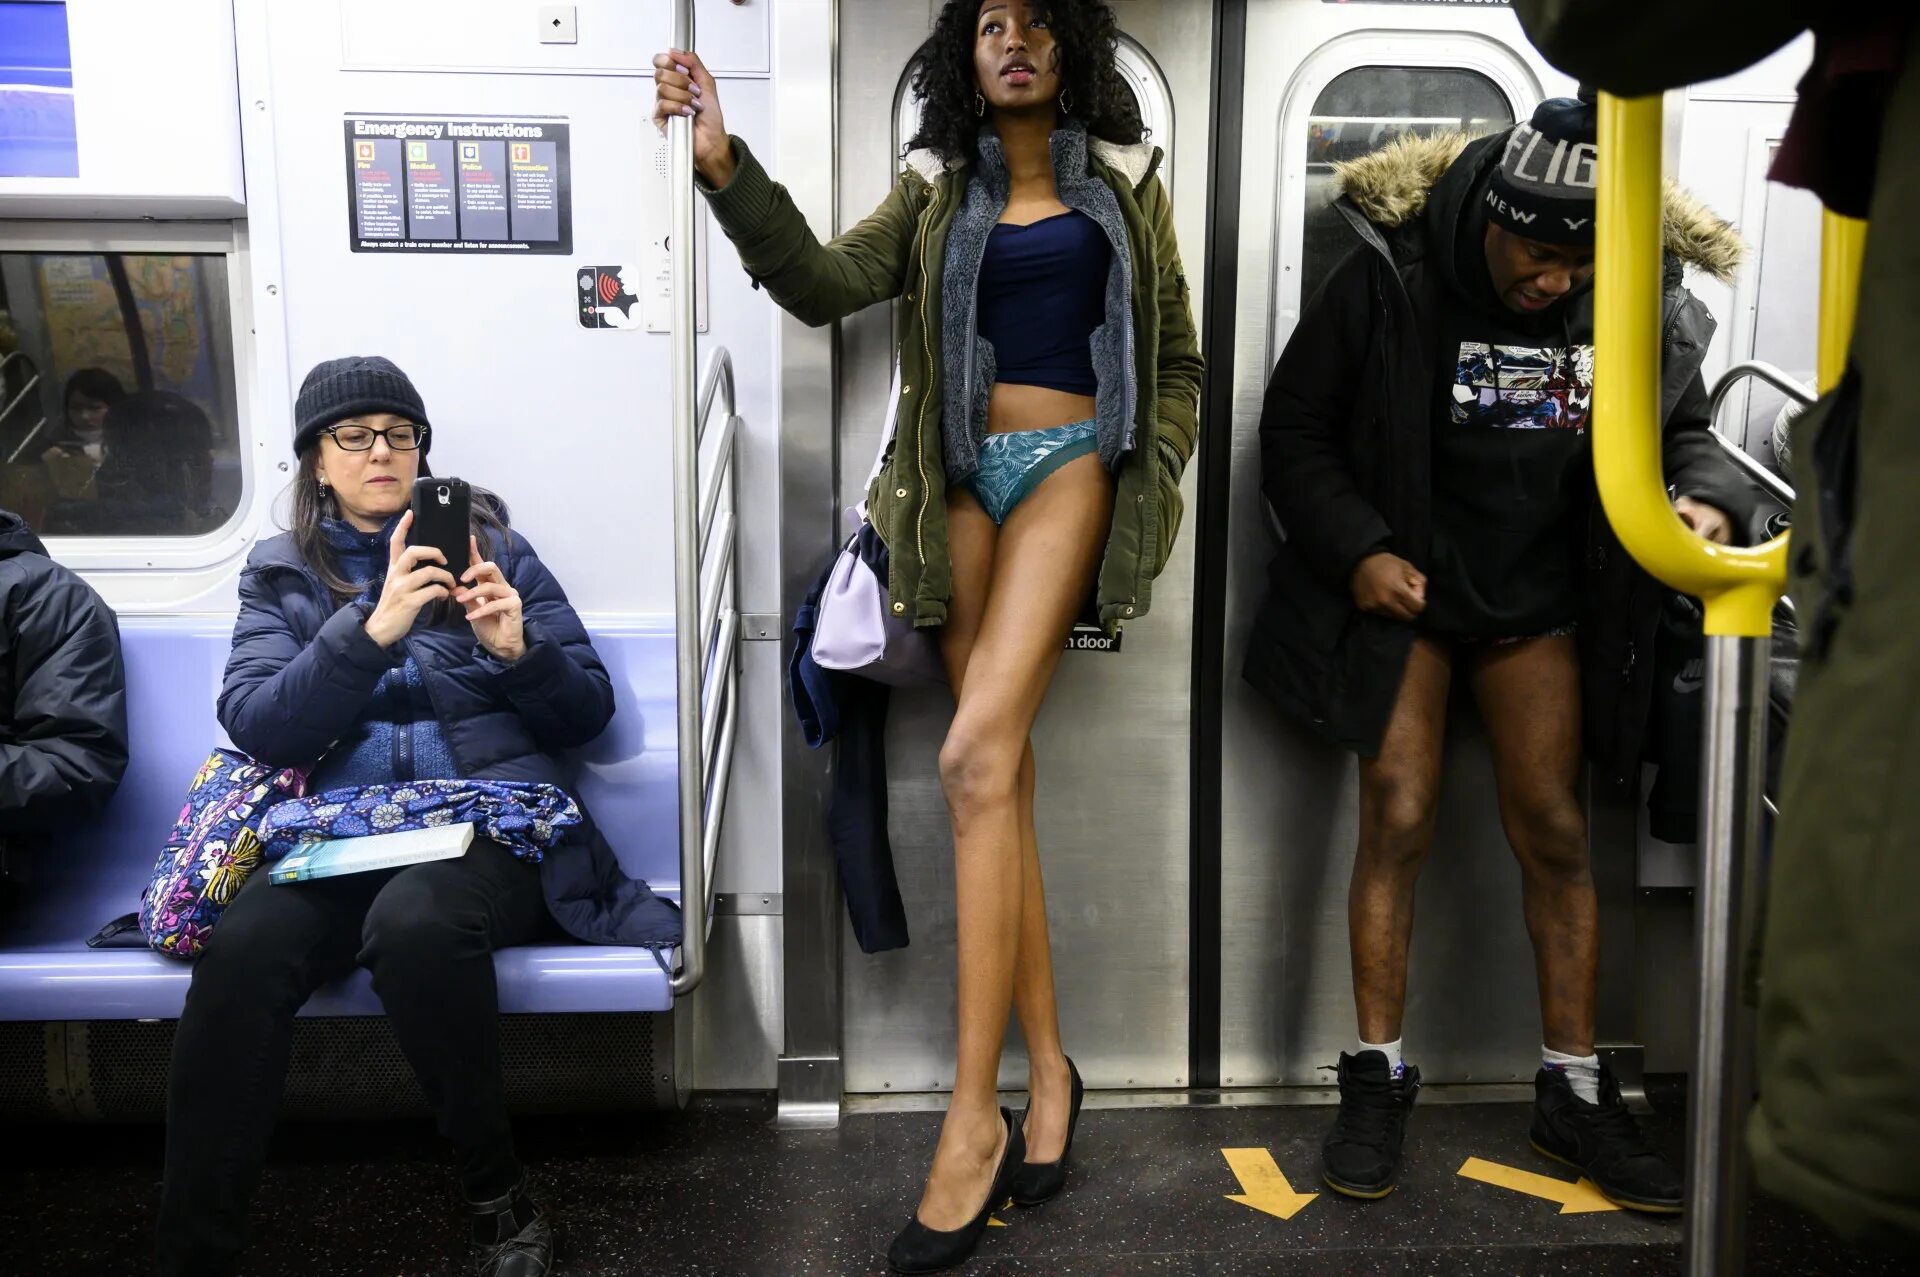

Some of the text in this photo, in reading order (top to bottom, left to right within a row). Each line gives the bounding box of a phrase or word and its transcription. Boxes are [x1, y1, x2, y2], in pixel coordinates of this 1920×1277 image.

[354, 120, 543, 139] Emergency Instructions
[1501, 121, 1598, 189] FLIG
[1486, 189, 1537, 224] NEW
[1077, 634, 1114, 649] door
